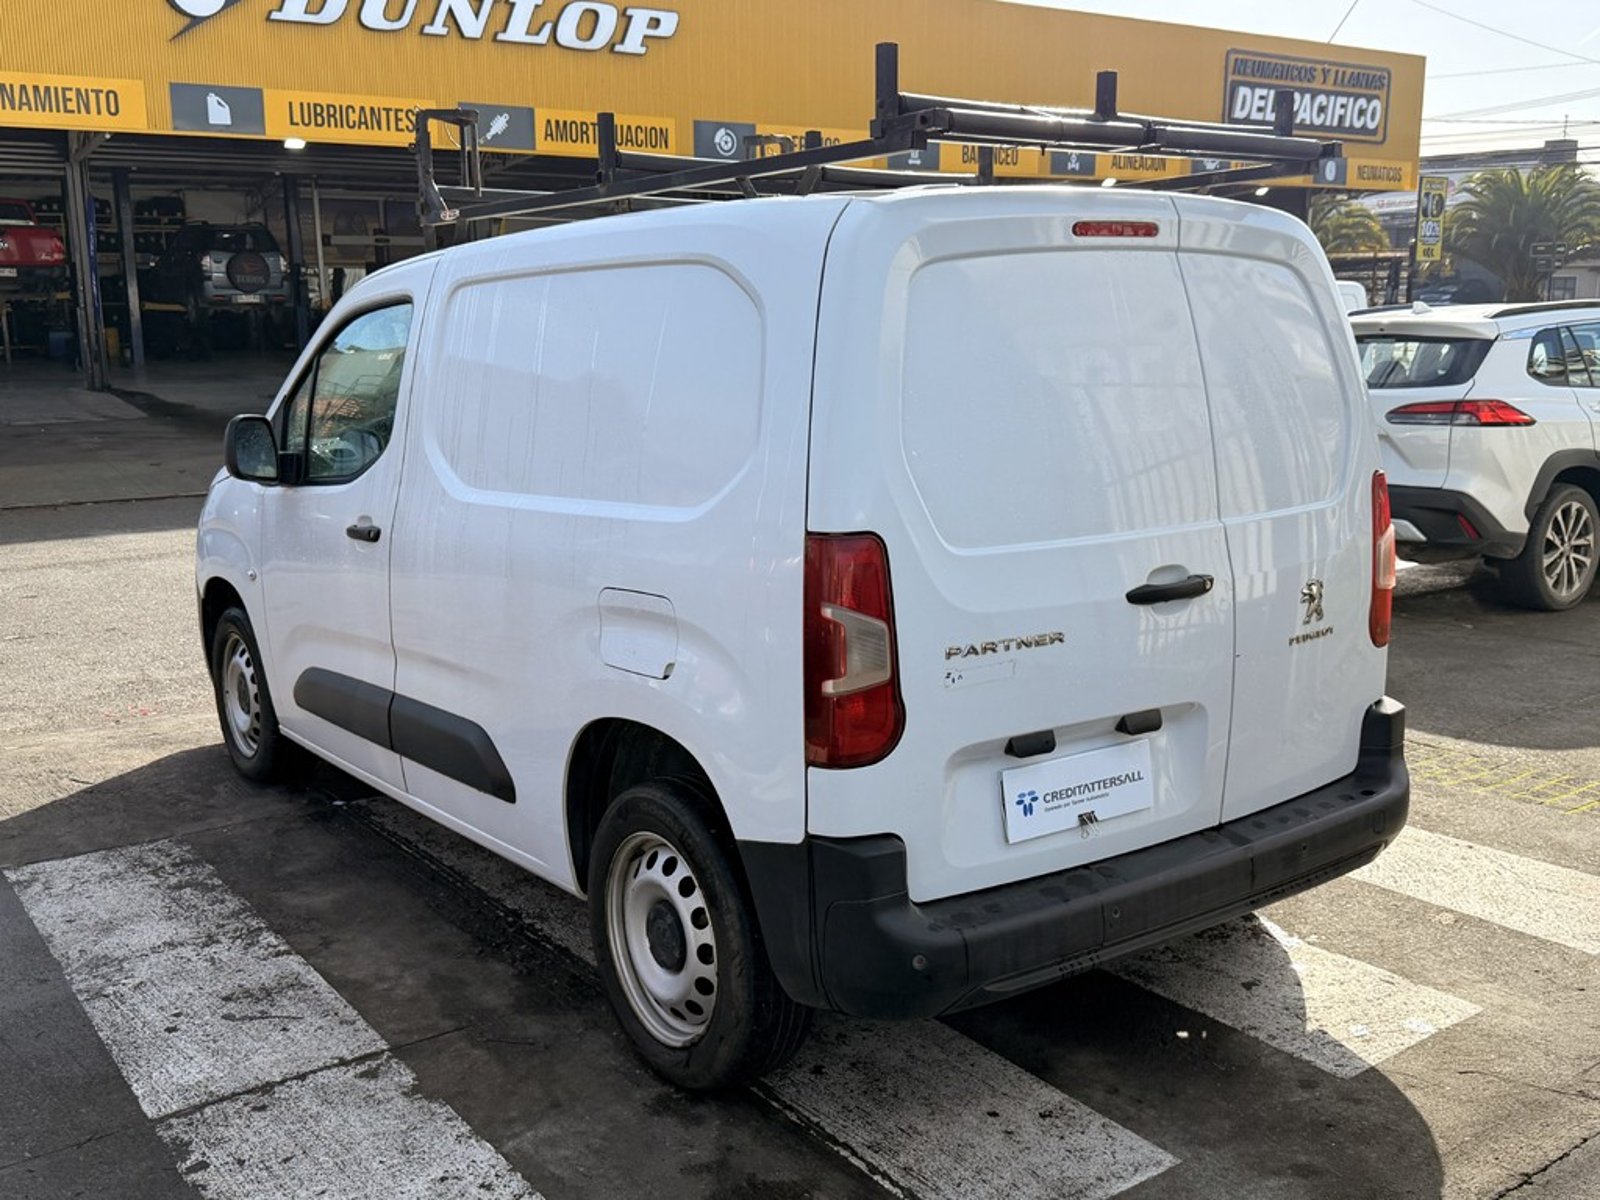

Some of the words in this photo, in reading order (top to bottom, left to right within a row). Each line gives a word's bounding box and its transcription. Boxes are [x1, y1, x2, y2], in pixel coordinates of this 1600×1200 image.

[266, 0, 680, 54] DUNLOP
[1233, 58, 1317, 83] NEUMATICOS
[1321, 65, 1332, 85] Y
[288, 101, 416, 133] LUBRICANTES
[1233, 86, 1276, 122] DEL
[544, 119, 669, 149] AMORTUACION
[962, 144, 1018, 166] BANCEO
[1357, 164, 1403, 183] NEUMATICOS
[945, 632, 1065, 660] PARTNER
[1043, 770, 1144, 804] CREDITATTERSALL
